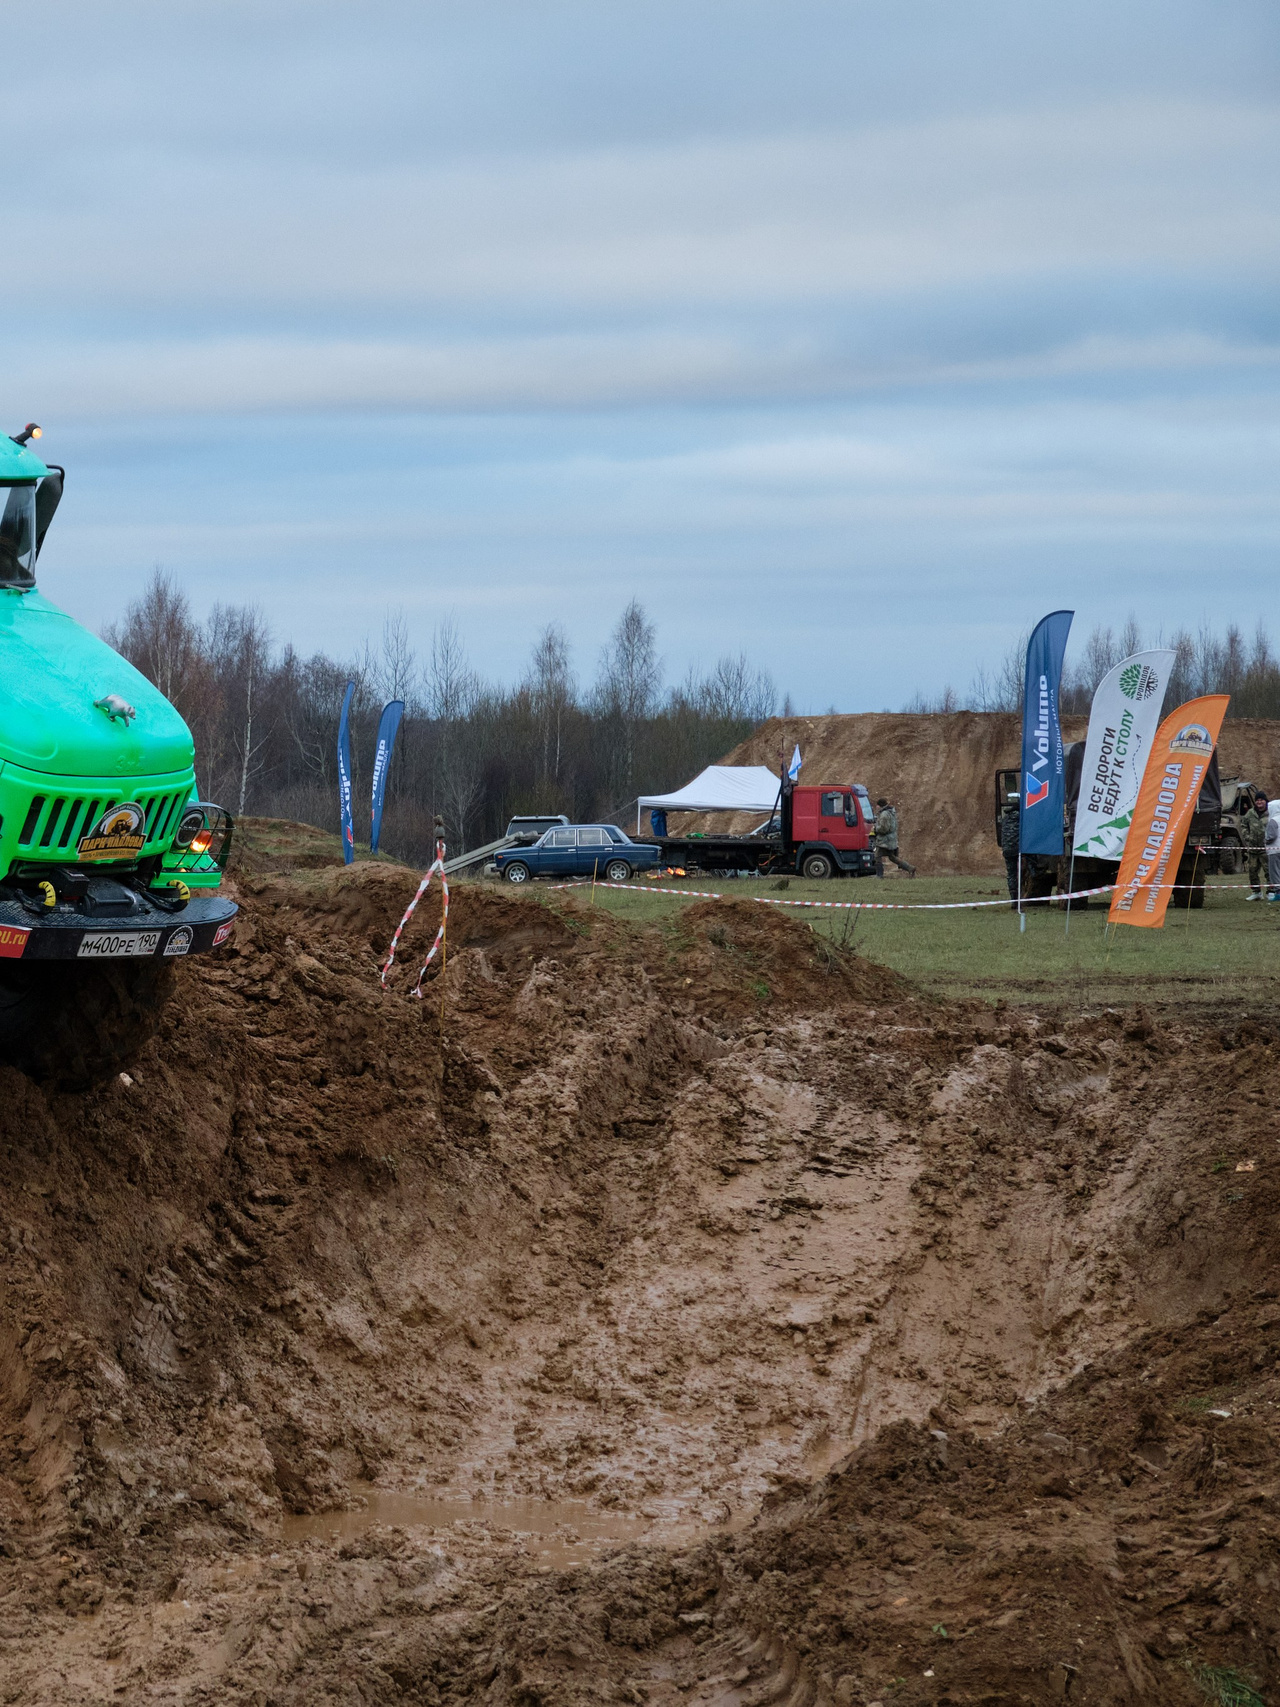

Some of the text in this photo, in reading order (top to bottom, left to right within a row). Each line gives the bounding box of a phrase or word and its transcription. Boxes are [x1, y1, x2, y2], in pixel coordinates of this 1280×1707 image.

[1032, 674, 1049, 772] Volume
[1102, 709, 1135, 816] ВЕДУТ К СТОЛУ
[1088, 727, 1117, 813] ВСЕ ДОРОГИ
[80, 837, 106, 851] ПАРК
[1116, 762, 1183, 912] ПАРК ПАВЛОВА
[139, 934, 156, 947] 190
